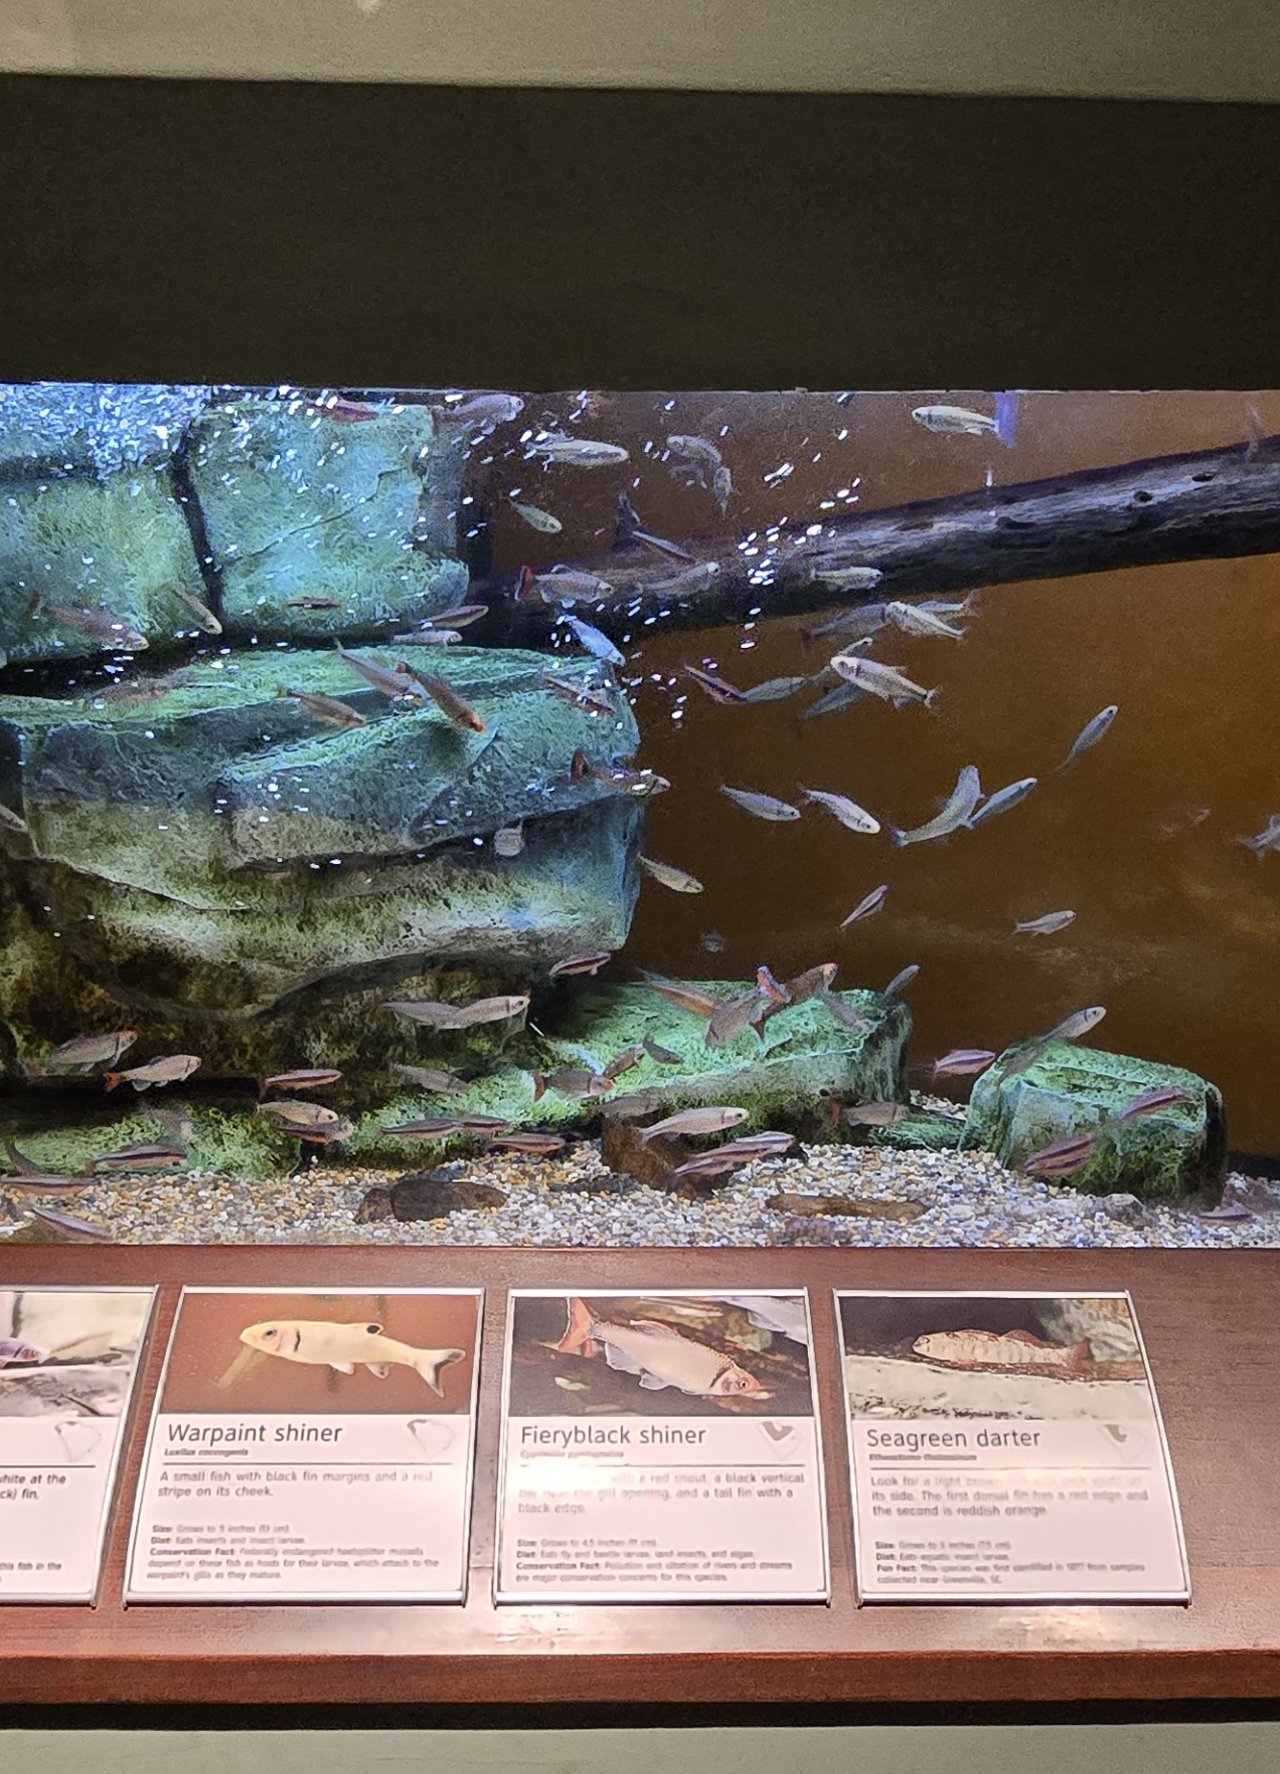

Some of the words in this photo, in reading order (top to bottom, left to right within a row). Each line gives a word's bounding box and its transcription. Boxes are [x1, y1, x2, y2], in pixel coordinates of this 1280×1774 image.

[169, 1424, 266, 1446] Warpaint
[274, 1424, 342, 1442] shiner
[522, 1425, 630, 1448] Fieryblack
[640, 1425, 706, 1444] shiner
[867, 1429, 967, 1452] Seagreen
[977, 1429, 1040, 1447] darter
[30, 1474, 42, 1484] at
[47, 1474, 66, 1484] the
[160, 1471, 168, 1481] A
[174, 1471, 205, 1482] small
[210, 1471, 231, 1481] fish
[236, 1472, 261, 1481] with
[266, 1471, 297, 1481] black
[303, 1470, 318, 1481] fin
[322, 1473, 370, 1485] margins
[375, 1471, 397, 1482] and
[402, 1473, 408, 1482] a
[650, 1474, 670, 1484] red
[714, 1475, 721, 1483] a
[726, 1473, 756, 1483] black
[761, 1473, 804, 1483] vertical
[870, 1476, 898, 1486] Look
[902, 1476, 919, 1486] for
[158, 1487, 191, 1499] stripe
[196, 1488, 211, 1497] on
[216, 1486, 230, 1496] its
[676, 1488, 698, 1498] and
[703, 1490, 710, 1498] a
[714, 1488, 732, 1498] tail
[737, 1487, 752, 1498] fin
[756, 1488, 782, 1498] with
[786, 1489, 793, 1498] a
[921, 1490, 942, 1501] The
[946, 1489, 968, 1501] first
[971, 1490, 1009, 1501] dorsal
[1013, 1489, 1029, 1499] fin
[1126, 1490, 1148, 1501] and
[518, 1502, 550, 1513] black
[873, 1506, 892, 1516] the
[896, 1506, 938, 1516] second
[943, 1505, 953, 1516] is
[957, 1505, 1000, 1516] reddish
